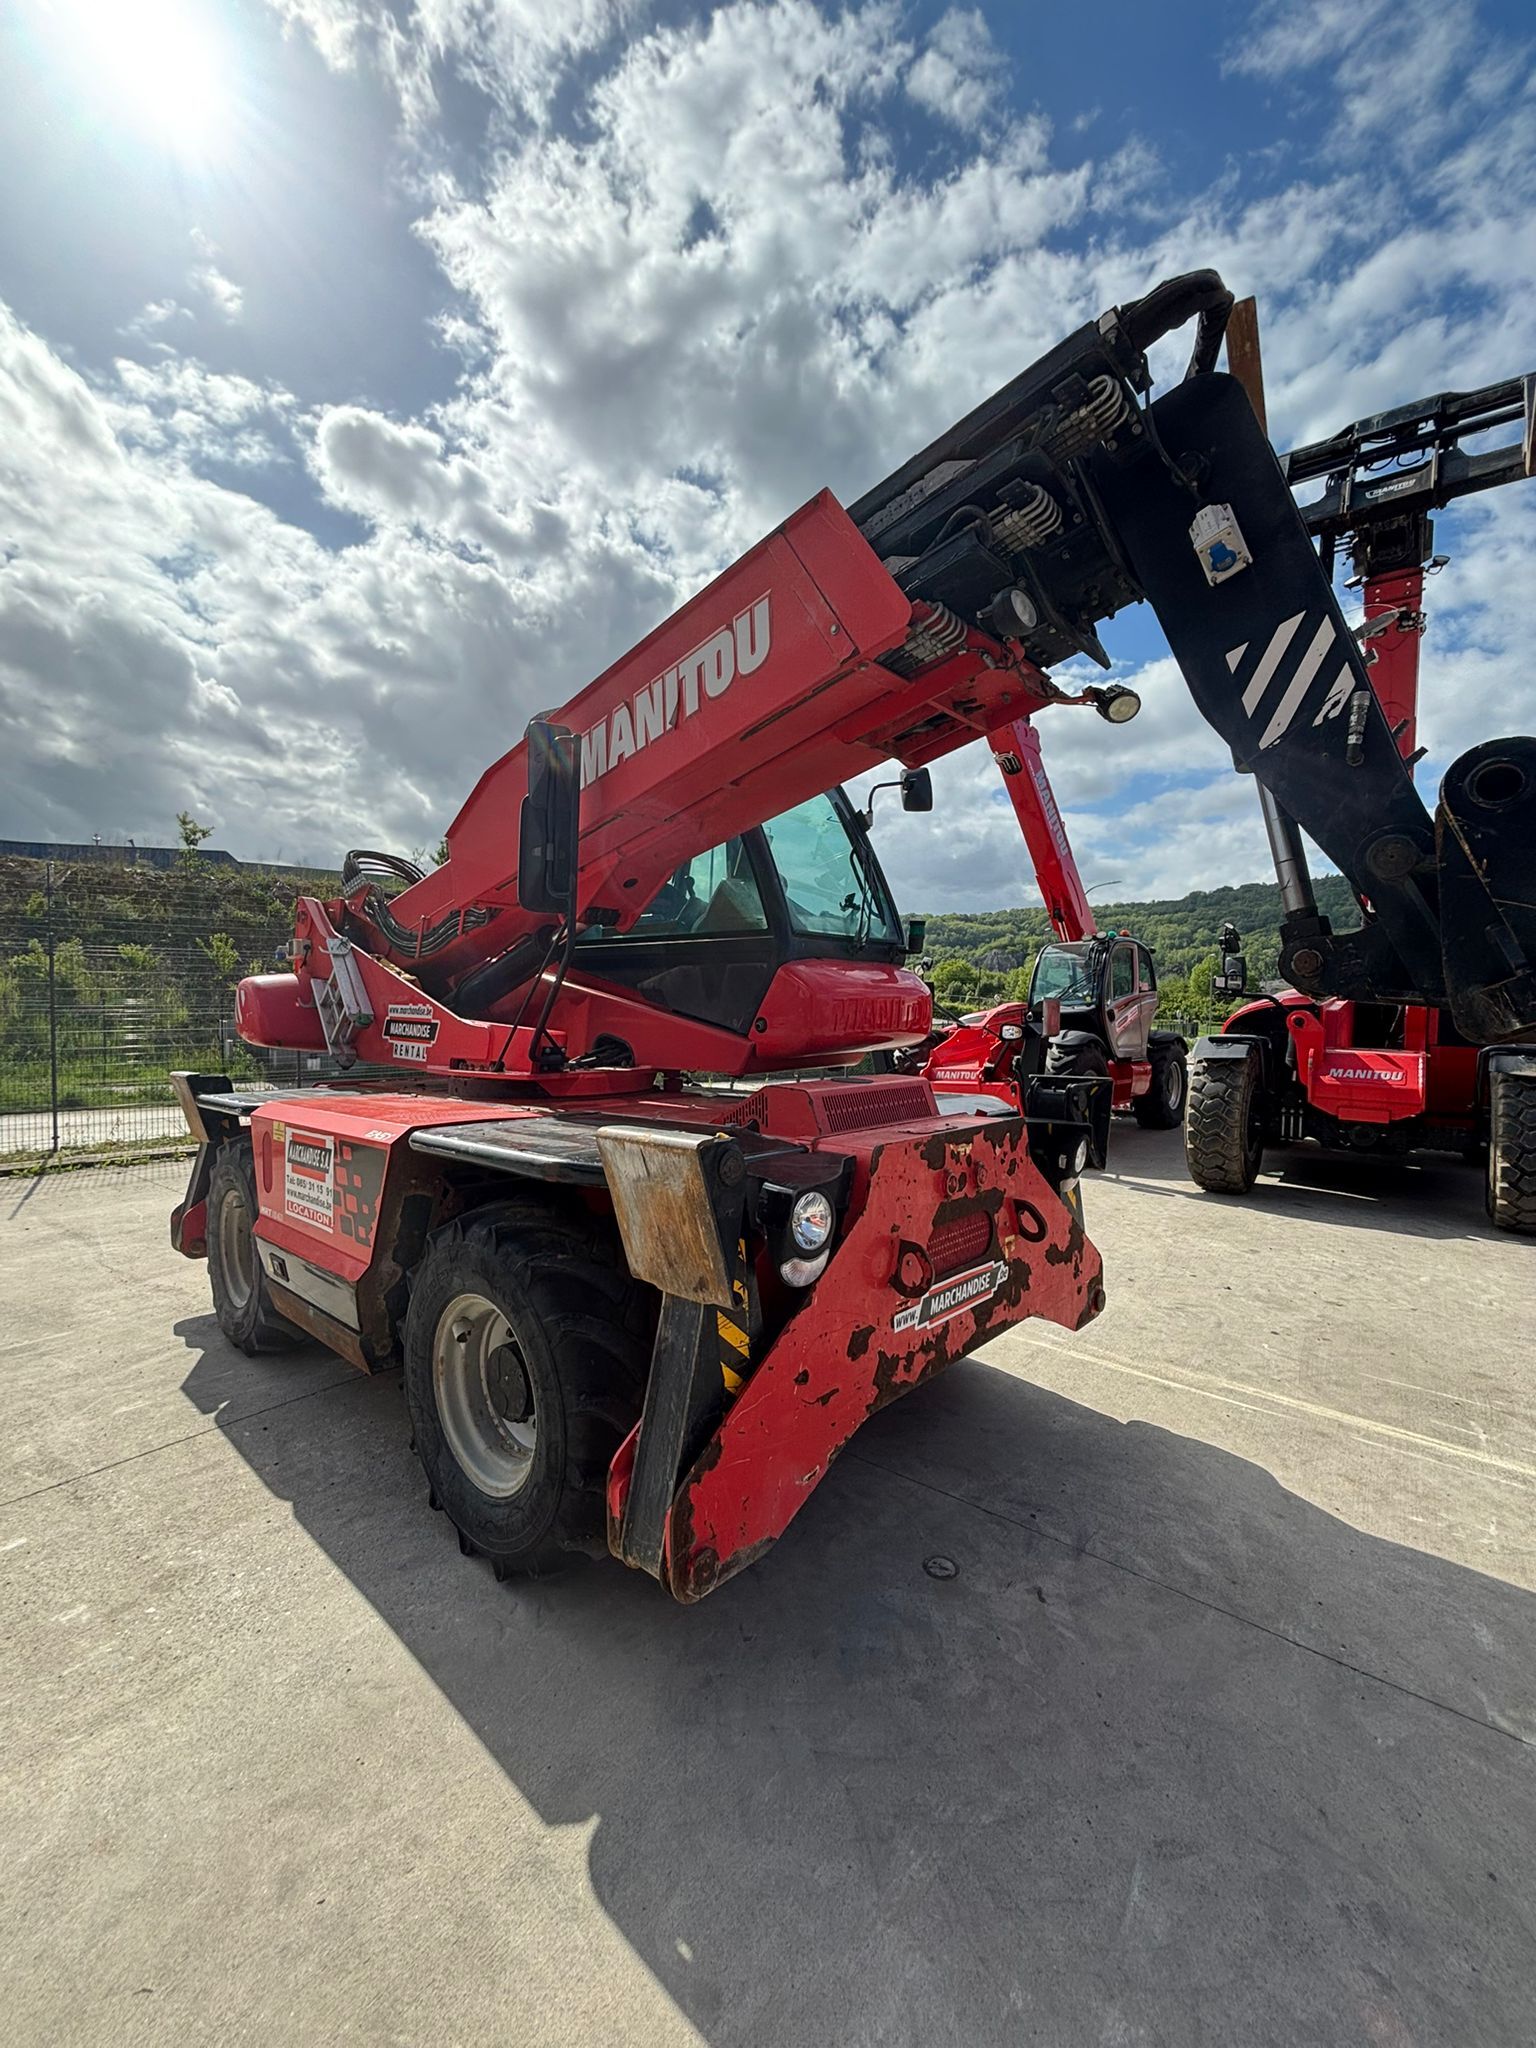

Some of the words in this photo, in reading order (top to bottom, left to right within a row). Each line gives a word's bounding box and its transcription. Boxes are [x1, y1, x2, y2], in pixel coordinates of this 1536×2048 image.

[580, 588, 772, 790] MANITOU
[1035, 769, 1069, 857] MANITOU
[390, 1022, 431, 1038] MARCHANDISE
[394, 1043, 426, 1059] RENTAL
[935, 1070, 978, 1080] MANITOU
[1329, 1067, 1405, 1081] MANITOU
[289, 1142, 321, 1167] MARCHANDISE
[288, 1200, 330, 1226] LOCATION
[930, 1272, 992, 1316] MARCHANDISE
